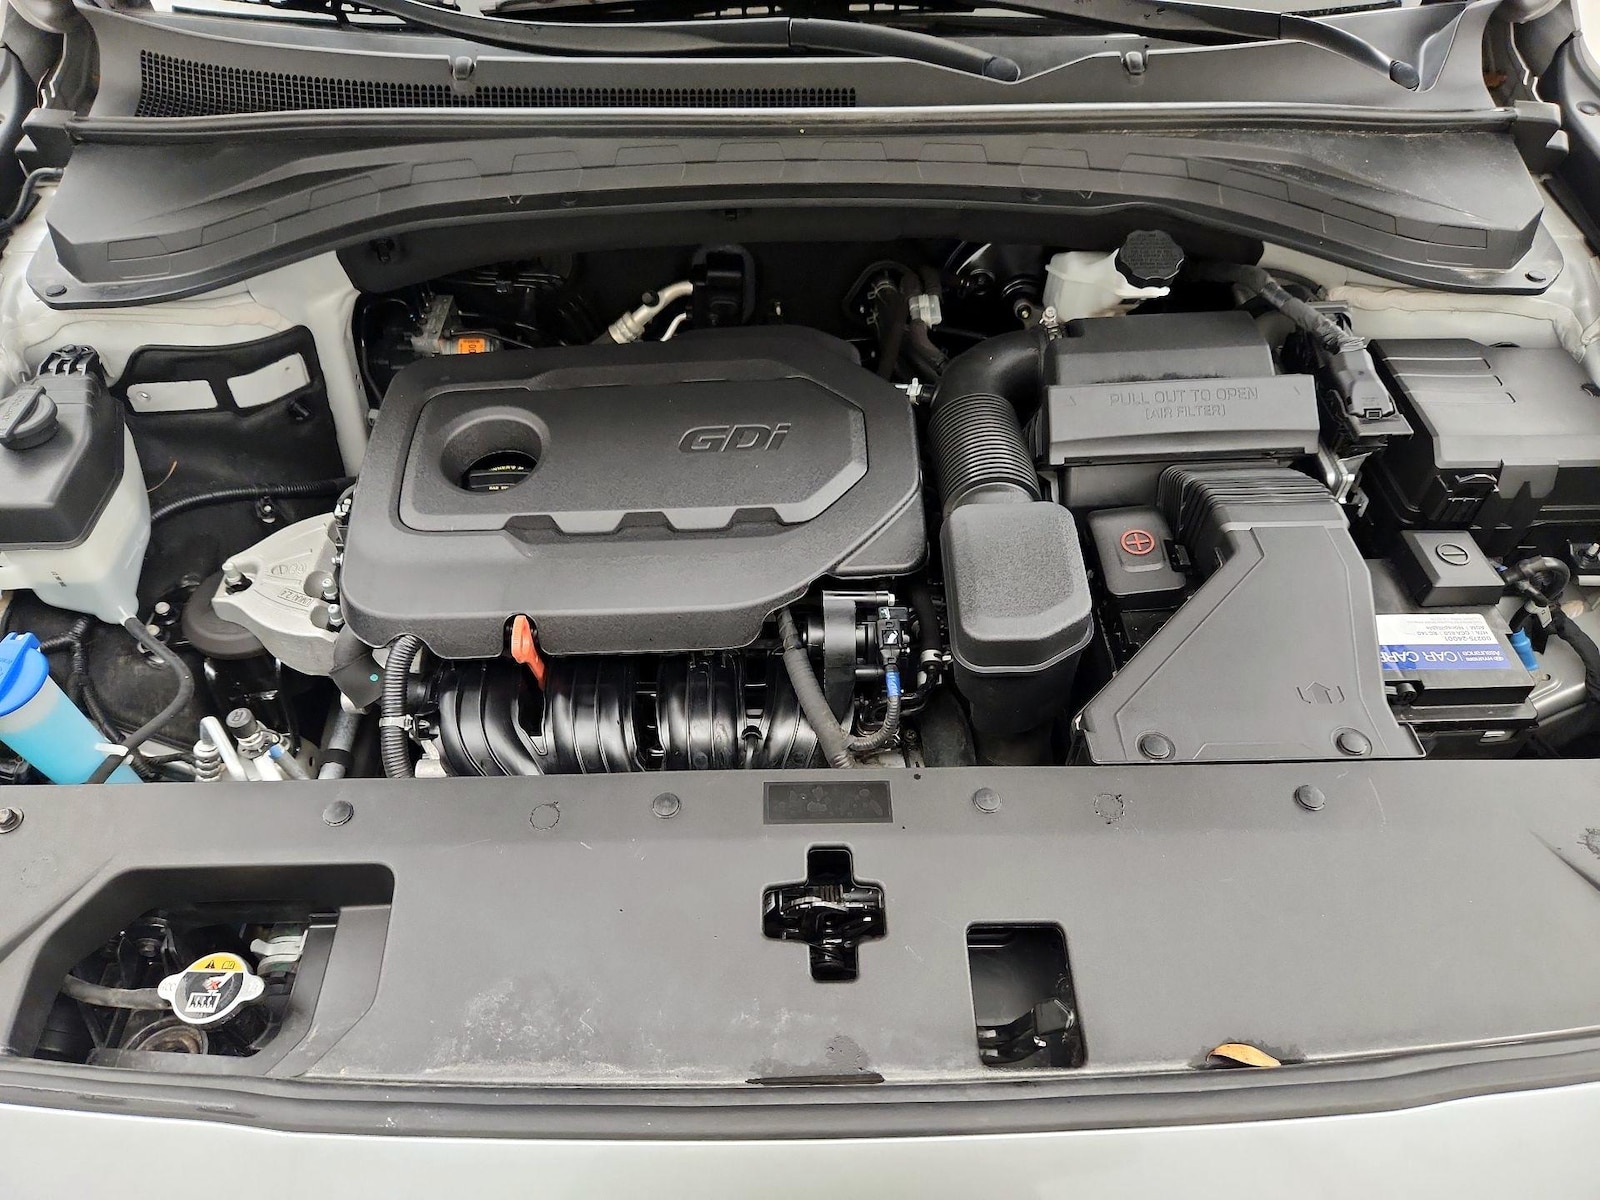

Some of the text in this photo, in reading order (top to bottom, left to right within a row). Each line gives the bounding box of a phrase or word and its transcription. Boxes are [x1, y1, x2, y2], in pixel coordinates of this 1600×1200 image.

[1110, 387, 1258, 406] PULL OUT TO OPEN
[679, 423, 791, 452] GDi
[1422, 651, 1457, 662] CAR
